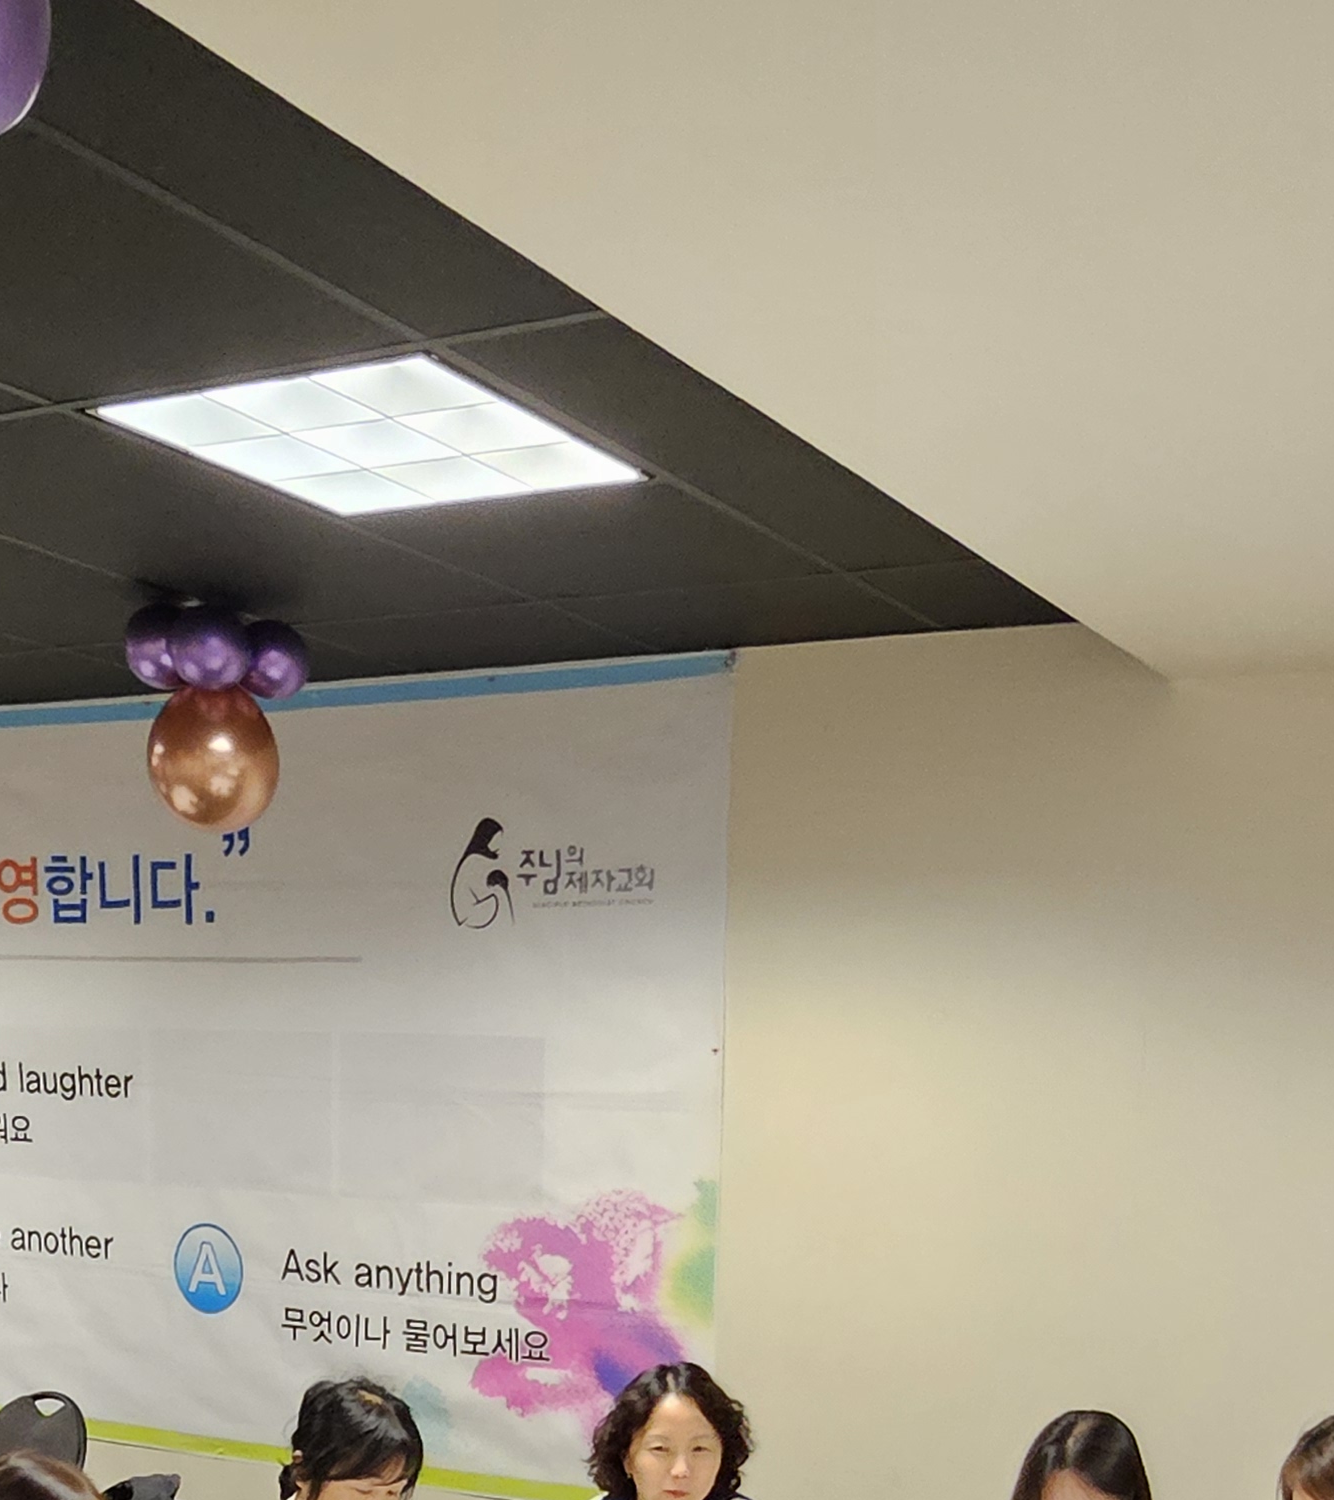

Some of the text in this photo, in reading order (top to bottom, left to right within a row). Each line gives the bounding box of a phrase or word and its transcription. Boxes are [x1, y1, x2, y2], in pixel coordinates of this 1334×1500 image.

[564, 864, 655, 895] 제자교회
[18, 1062, 134, 1101] laughter
[10, 1227, 114, 1260] another
[187, 1240, 227, 1296] A
[281, 1248, 498, 1304] Ask anything
[280, 1306, 551, 1363] 무엇이나 물어보세요
